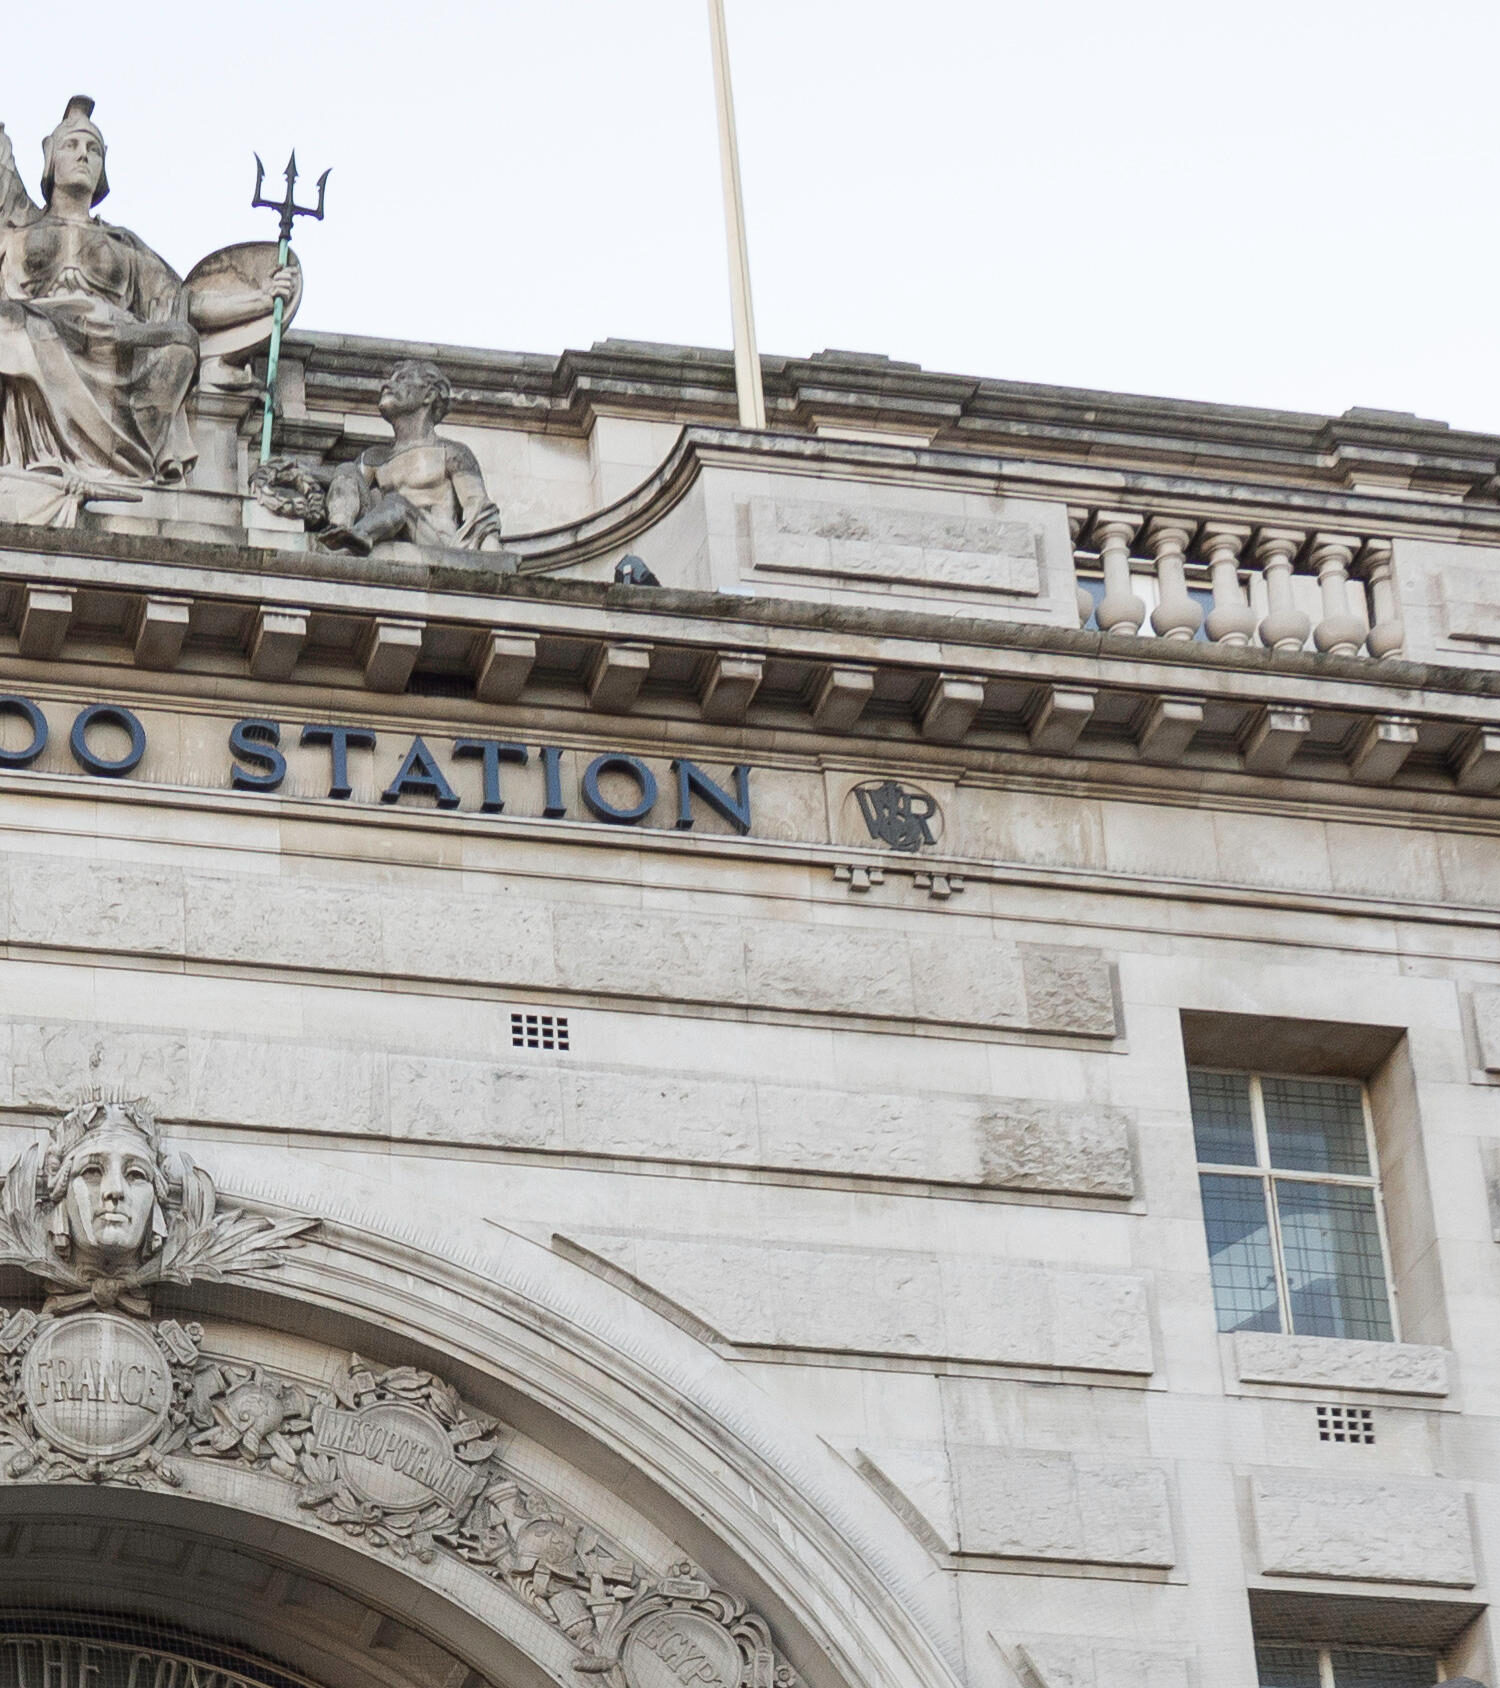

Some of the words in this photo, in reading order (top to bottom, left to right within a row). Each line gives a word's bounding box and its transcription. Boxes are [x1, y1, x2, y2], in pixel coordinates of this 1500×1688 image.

[229, 721, 752, 837] STATION
[36, 1355, 163, 1413] FRANCE
[320, 1408, 474, 1500] MESOPOTAMIA
